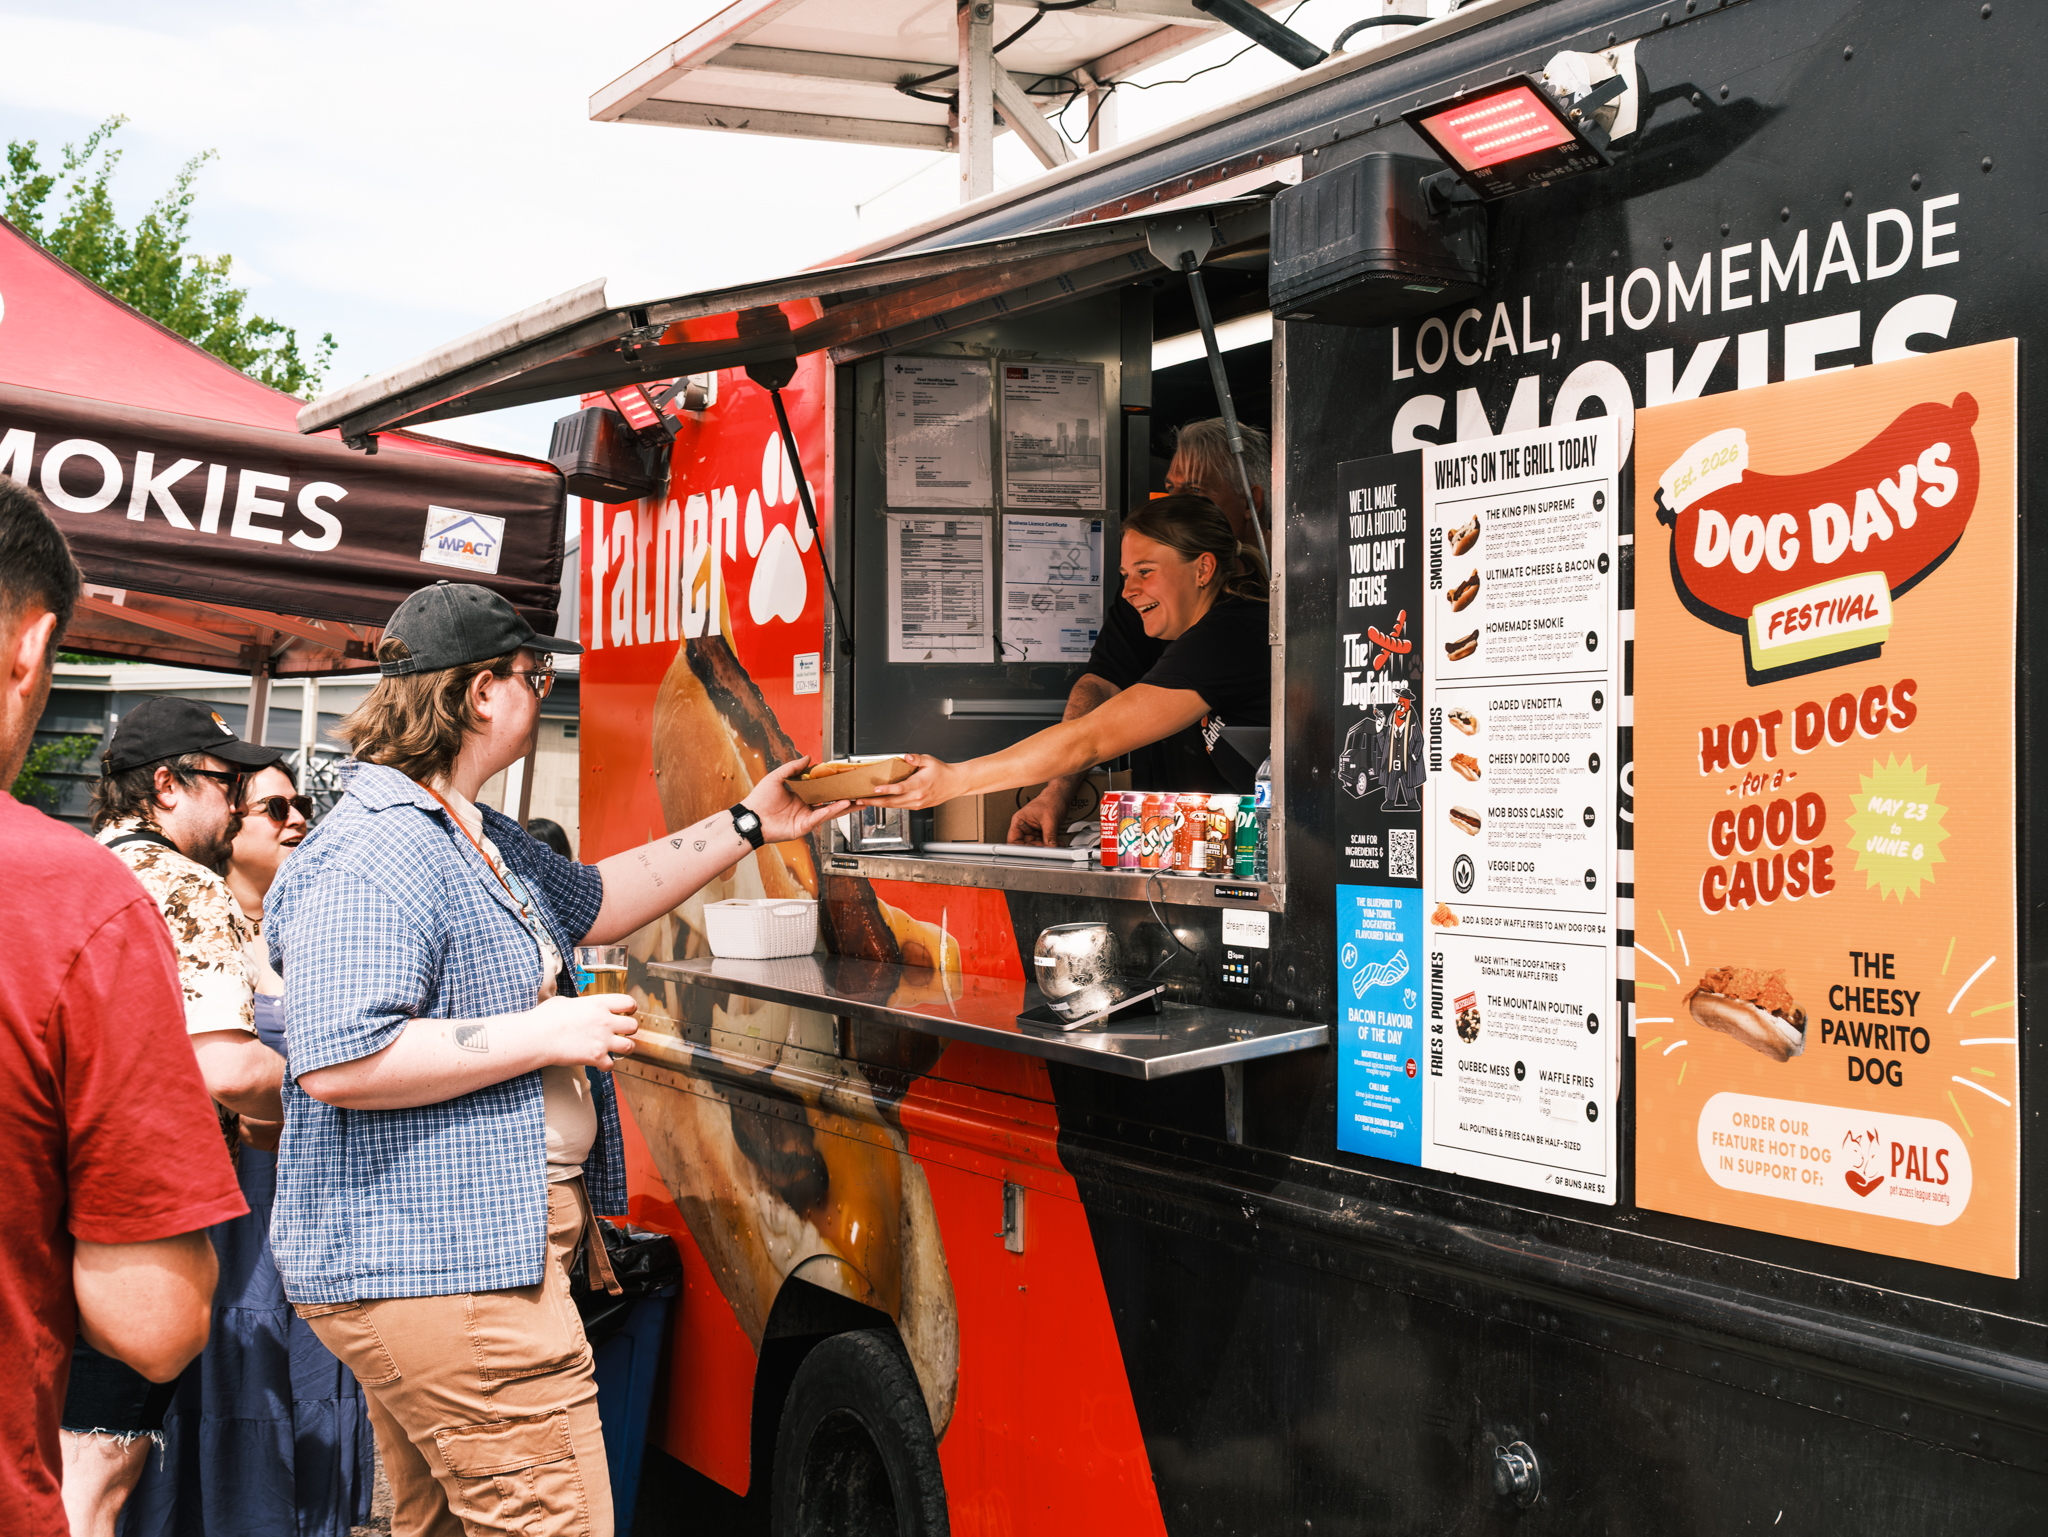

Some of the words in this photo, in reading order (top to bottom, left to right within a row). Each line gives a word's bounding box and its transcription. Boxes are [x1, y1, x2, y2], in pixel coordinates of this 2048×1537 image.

[1392, 295, 1561, 380] LOCAL,
[1580, 193, 1960, 341] HOMEMADE
[1434, 454, 1478, 490] WHAT'S
[1480, 450, 1497, 483] ON
[1499, 446, 1521, 480] THE
[1523, 441, 1555, 477] GRILL
[1557, 434, 1598, 471] TODAY
[1673, 465, 1697, 498] Est.
[1700, 444, 1739, 472] 2026
[1349, 488, 1373, 513] WE'LL
[1374, 484, 1397, 509] MAKE
[1485, 508, 1501, 520] THE
[1501, 505, 1522, 518] KING
[1522, 503, 1537, 515] PIN
[1537, 498, 1575, 513] SUPREME
[1693, 508, 1800, 573] DOG
[1808, 442, 1958, 564] DAYS
[1349, 515, 1365, 538] YOU
[1366, 514, 1373, 536] A
[1374, 509, 1406, 535] HOTDOG
[462, 554, 488, 564] canopy
[1349, 543, 1370, 574] YOU
[1373, 539, 1405, 571] CAN'T
[1430, 527, 1443, 590] SMOKIES
[1485, 566, 1524, 580] ULTIMATE
[1525, 563, 1555, 576] CHEESE
[1556, 562, 1563, 573] &
[1564, 559, 1595, 572] BACON
[1348, 575, 1388, 607] REFUSE
[1486, 620, 1532, 633] HOMEMADE
[1533, 617, 1564, 629] SMOKIE
[1768, 594, 1879, 640] FESTIVAL
[1343, 633, 1368, 668] The
[1489, 699, 1519, 710] LOADED
[1523, 697, 1561, 709] VENDETTA
[1430, 707, 1443, 772] HOTDOGS
[1698, 710, 1783, 776] HOT
[1791, 679, 1917, 754] DOGS
[1489, 753, 1518, 764] CHEESY
[1520, 753, 1550, 763] DORITO
[1552, 752, 1570, 763] DOG
[1488, 807, 1506, 817] MOB
[1508, 807, 1528, 817] BOSS
[1530, 807, 1564, 818] CLASSIC
[1868, 796, 1903, 817] MAY
[1904, 802, 1928, 822] 23
[1708, 792, 1826, 860] GOOD
[1890, 823, 1902, 835] to
[1351, 834, 1366, 844] SCAN
[1367, 835, 1378, 844] FOR
[1866, 836, 1910, 858] JUNE
[1912, 844, 1924, 860] 6
[1345, 846, 1378, 857] INGREDIENTS
[1349, 858, 1380, 868] ALLERGENS
[1487, 860, 1515, 871] VEGGIE
[1517, 861, 1535, 872] DOG
[1699, 844, 1835, 915] CAUSE
[1356, 897, 1366, 906] THE
[1367, 897, 1393, 908] BLUEPRINT
[1394, 899, 1402, 908] TO
[1226, 919, 1244, 931] dream
[1246, 922, 1266, 935] image
[1355, 929, 1384, 940] FLAVOURED
[1385, 931, 1403, 942] BACON
[1462, 915, 1475, 924] ADD
[1475, 916, 1480, 925] A
[1480, 917, 1493, 926] SIDE
[1494, 918, 1502, 926] OF
[1503, 918, 1526, 928] WAFFLE
[1527, 920, 1544, 929] FRIES
[1544, 921, 1553, 930] TO
[1553, 921, 1568, 931] ANY
[1568, 922, 1583, 932] DOG
[1583, 923, 1597, 933] FOR
[1597, 924, 1606, 933] $4
[1474, 955, 1492, 964] MADE
[1492, 956, 1509, 965] WITH
[1510, 958, 1521, 967] THE
[1849, 951, 1895, 980] THE
[1481, 966, 1515, 977] SIGNATURE
[1516, 970, 1541, 980] WAFFLE
[1541, 972, 1559, 981] FRIES
[1431, 951, 1444, 1024] POUTINES
[1487, 995, 1502, 1006] THE
[1503, 996, 1547, 1011] MOUNTAIN
[1548, 1001, 1583, 1015] POUTINE
[1828, 984, 1920, 1017] CHEESY
[1348, 1007, 1376, 1024] BACON
[1378, 1011, 1413, 1029] FLAVOUR
[1431, 1024, 1444, 1034] &
[1358, 1025, 1369, 1040] OF
[1371, 1027, 1385, 1042] THE
[1388, 1029, 1402, 1045] DAY
[1821, 1018, 1930, 1054] PAWRITO
[1431, 1037, 1444, 1077] FRIES
[1457, 1059, 1488, 1073] QUEBEC
[1489, 1063, 1510, 1076] MESS
[1539, 1070, 1571, 1084] WAFFLE
[1572, 1074, 1594, 1087] FRIES
[1848, 1056, 1903, 1087] DOG
[1458, 1121, 1469, 1131] ALL
[1469, 1123, 1498, 1136] POUTINES
[1498, 1128, 1504, 1137] &
[1504, 1129, 1521, 1140] FRIES
[1521, 1132, 1536, 1143] CAN
[1536, 1135, 1544, 1145] BE
[1544, 1136, 1582, 1151] HALF-SIZED
[1732, 1112, 1776, 1132] ORDER
[1780, 1118, 1809, 1137] OUR
[1712, 1131, 1764, 1154] FEATURE
[1768, 1140, 1796, 1158] HOT
[1800, 1144, 1832, 1164] DOG
[1719, 1155, 1733, 1171] IN
[1738, 1158, 1798, 1182] SUPPORT
[1801, 1168, 1824, 1186] OF:
[1891, 1142, 1949, 1186] PALS
[1555, 1176, 1564, 1185] GF
[1564, 1177, 1582, 1189] BUNS
[1583, 1181, 1596, 1192] ARE
[1597, 1184, 1605, 1193] $2
[1899, 1187, 1913, 1198] access
[1915, 1187, 1931, 1202] league
[1932, 1191, 1949, 1206] society
